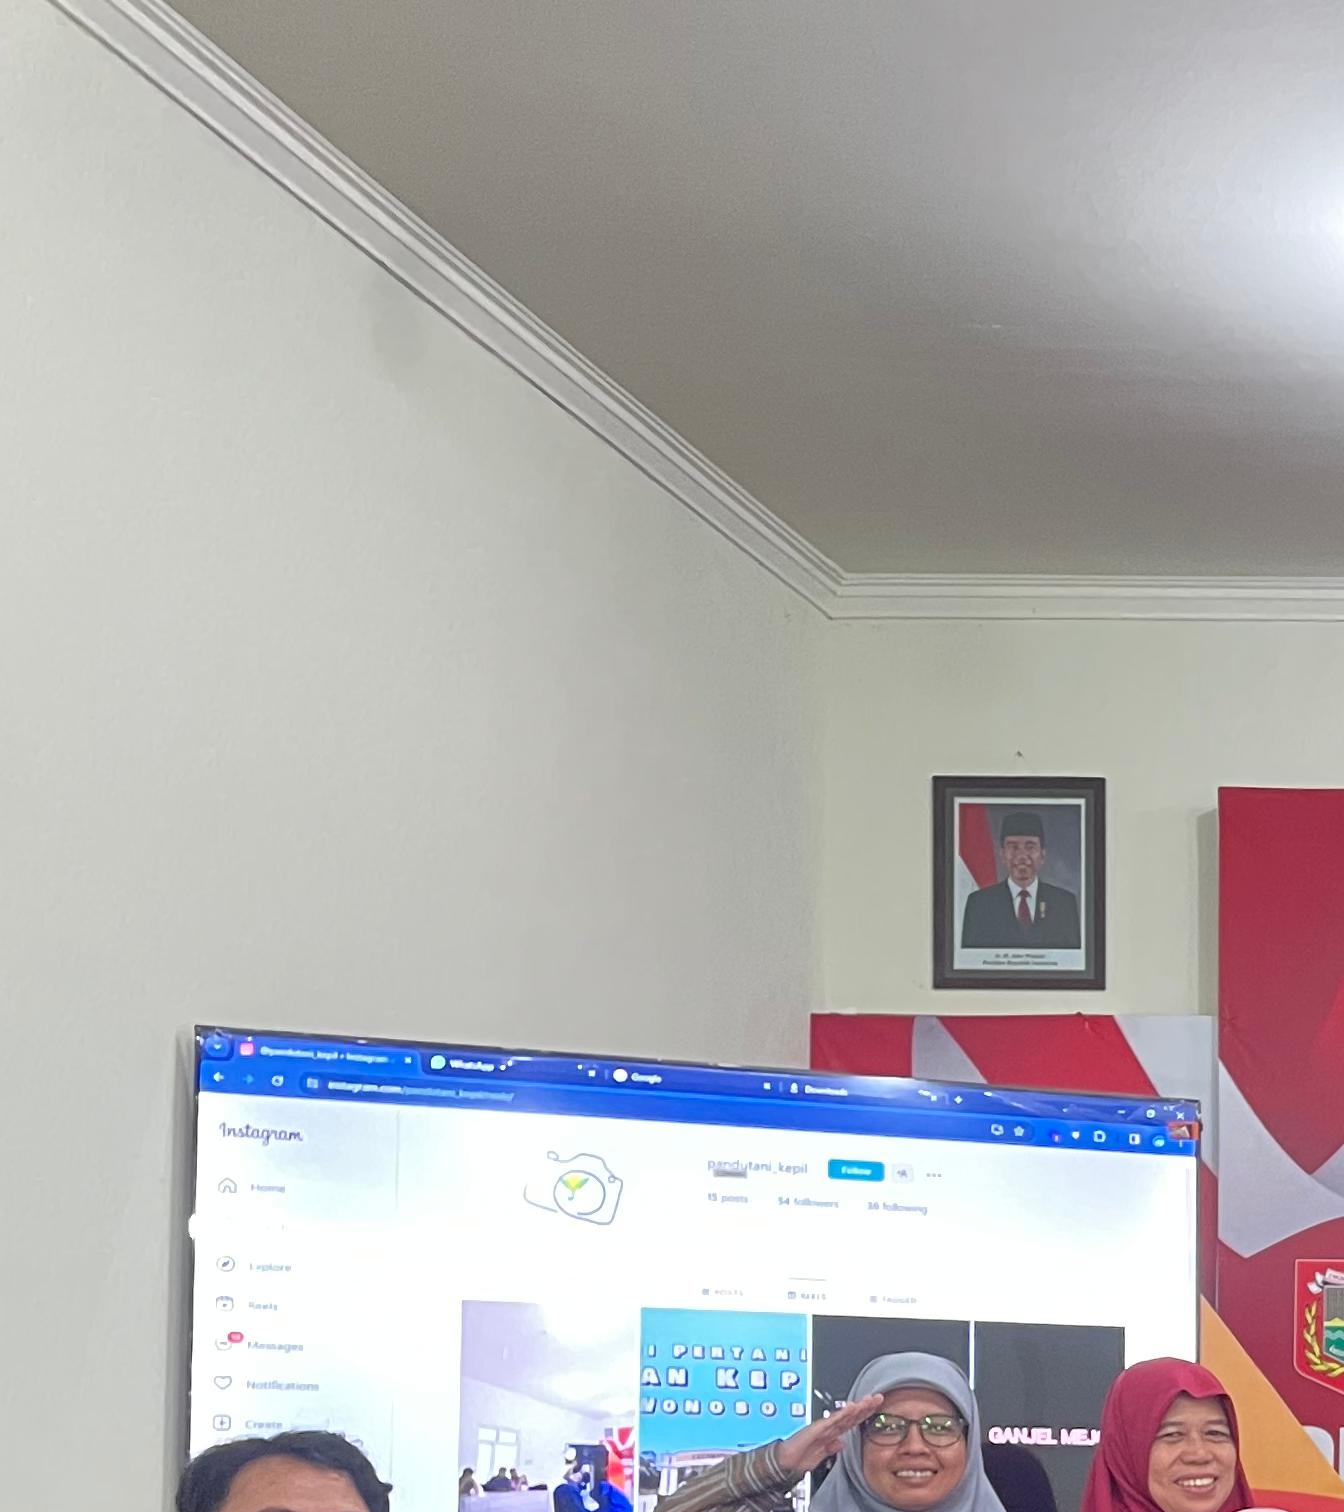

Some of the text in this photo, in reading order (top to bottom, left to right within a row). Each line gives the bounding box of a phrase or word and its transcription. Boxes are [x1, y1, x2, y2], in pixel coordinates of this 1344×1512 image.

[219, 1122, 304, 1146] Instagram
[721, 1194, 749, 1205] posts
[794, 1198, 839, 1209] followers
[883, 1201, 928, 1216] following
[248, 1341, 304, 1353] Messages
[641, 1366, 801, 1391] AN KEP
[247, 1380, 320, 1392] Notifications
[245, 1419, 283, 1430] Create
[988, 1426, 1058, 1446] GANJEL
